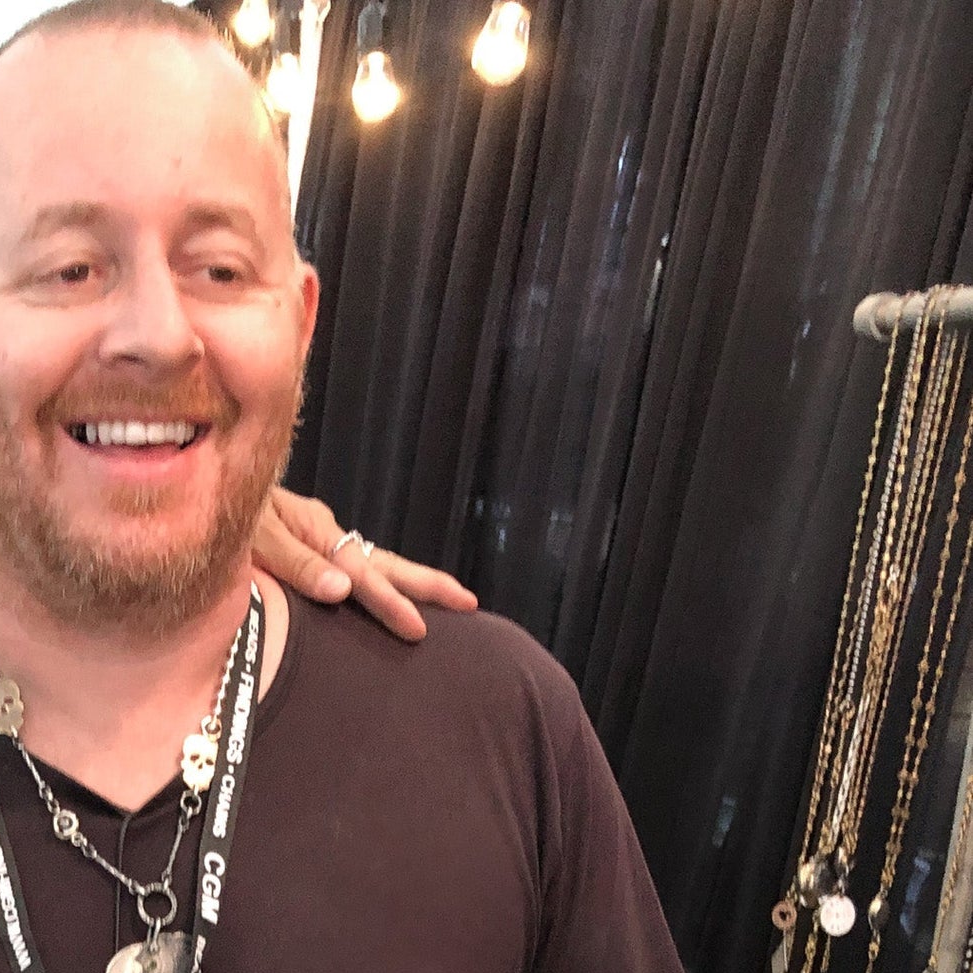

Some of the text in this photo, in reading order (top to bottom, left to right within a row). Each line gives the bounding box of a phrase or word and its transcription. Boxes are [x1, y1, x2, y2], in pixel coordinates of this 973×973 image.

[227, 671, 255, 765] FINDINGS
[213, 774, 235, 838] CHAINS
[201, 852, 226, 925] CGM
